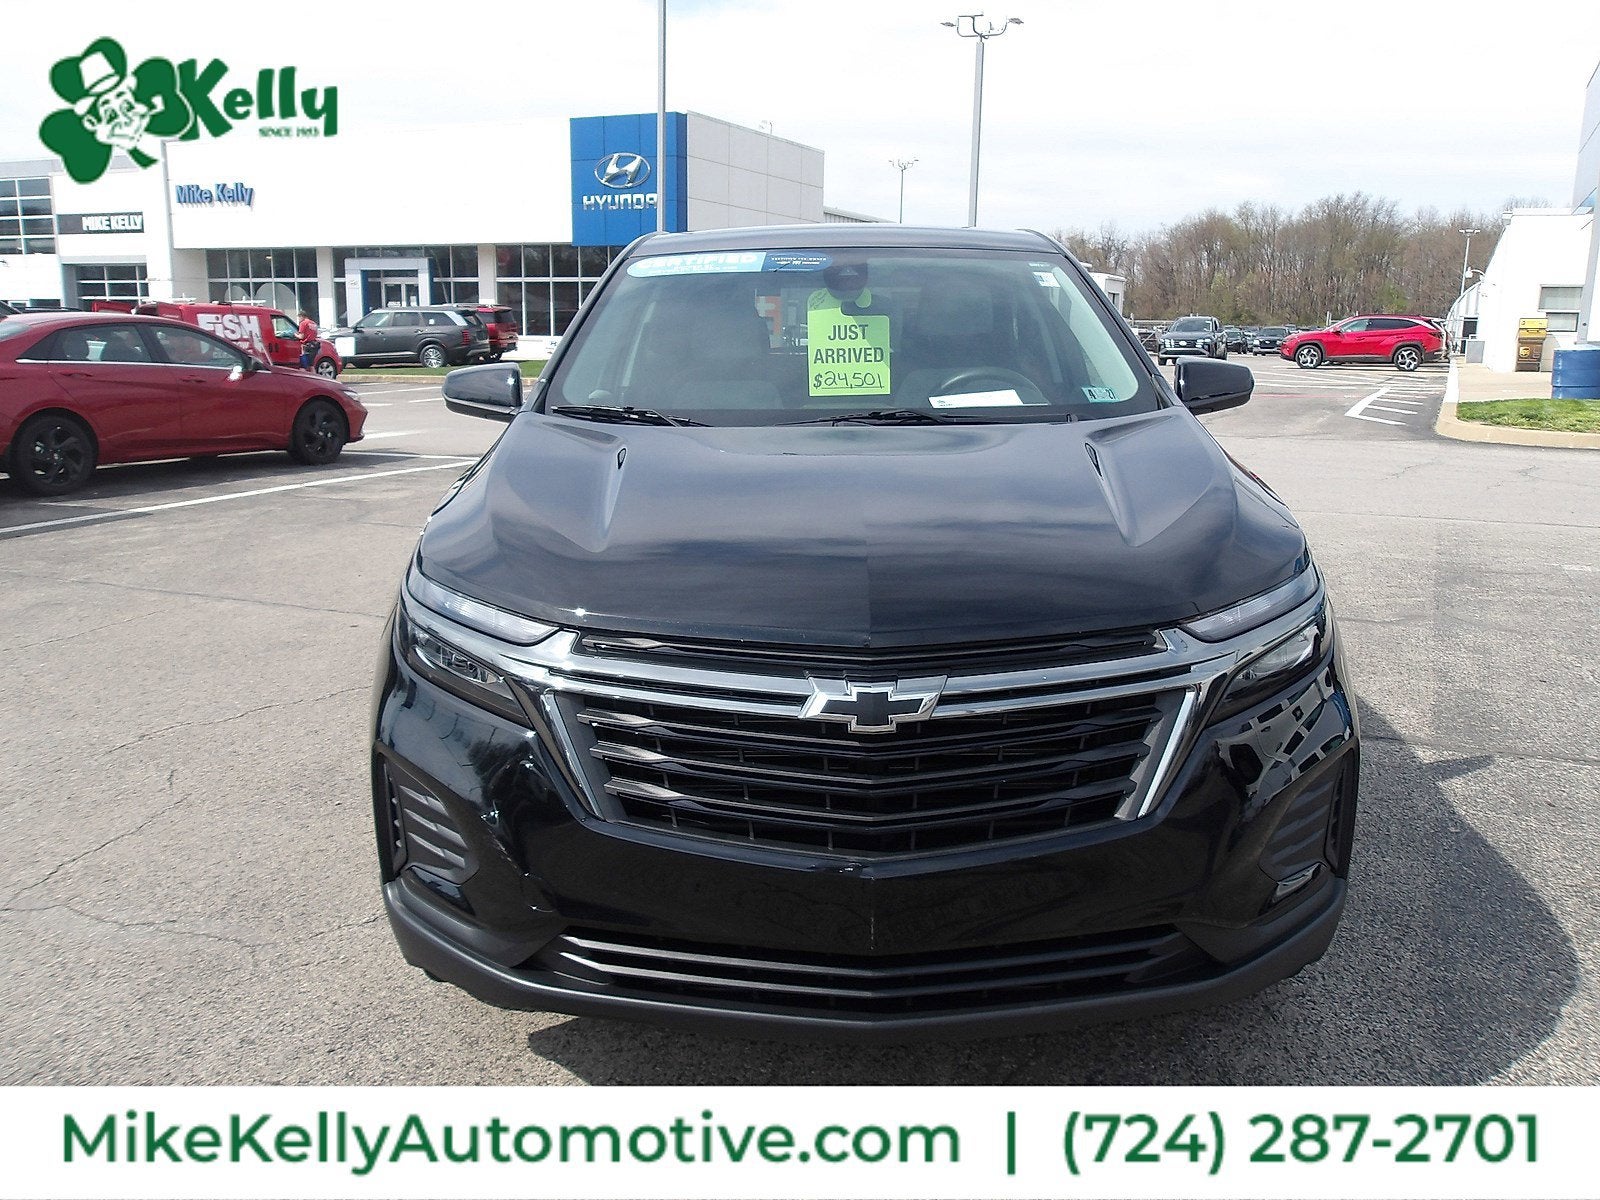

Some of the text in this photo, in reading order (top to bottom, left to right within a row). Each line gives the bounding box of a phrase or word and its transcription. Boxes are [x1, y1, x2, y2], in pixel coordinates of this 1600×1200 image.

[176, 182, 254, 207] Mike Kelly
[582, 193, 658, 210] HYUNDA
[82, 215, 142, 231] MIKE KELLY
[828, 324, 869, 341] JUST
[813, 347, 884, 364] ARRIVED
[813, 370, 883, 390] $24,501
